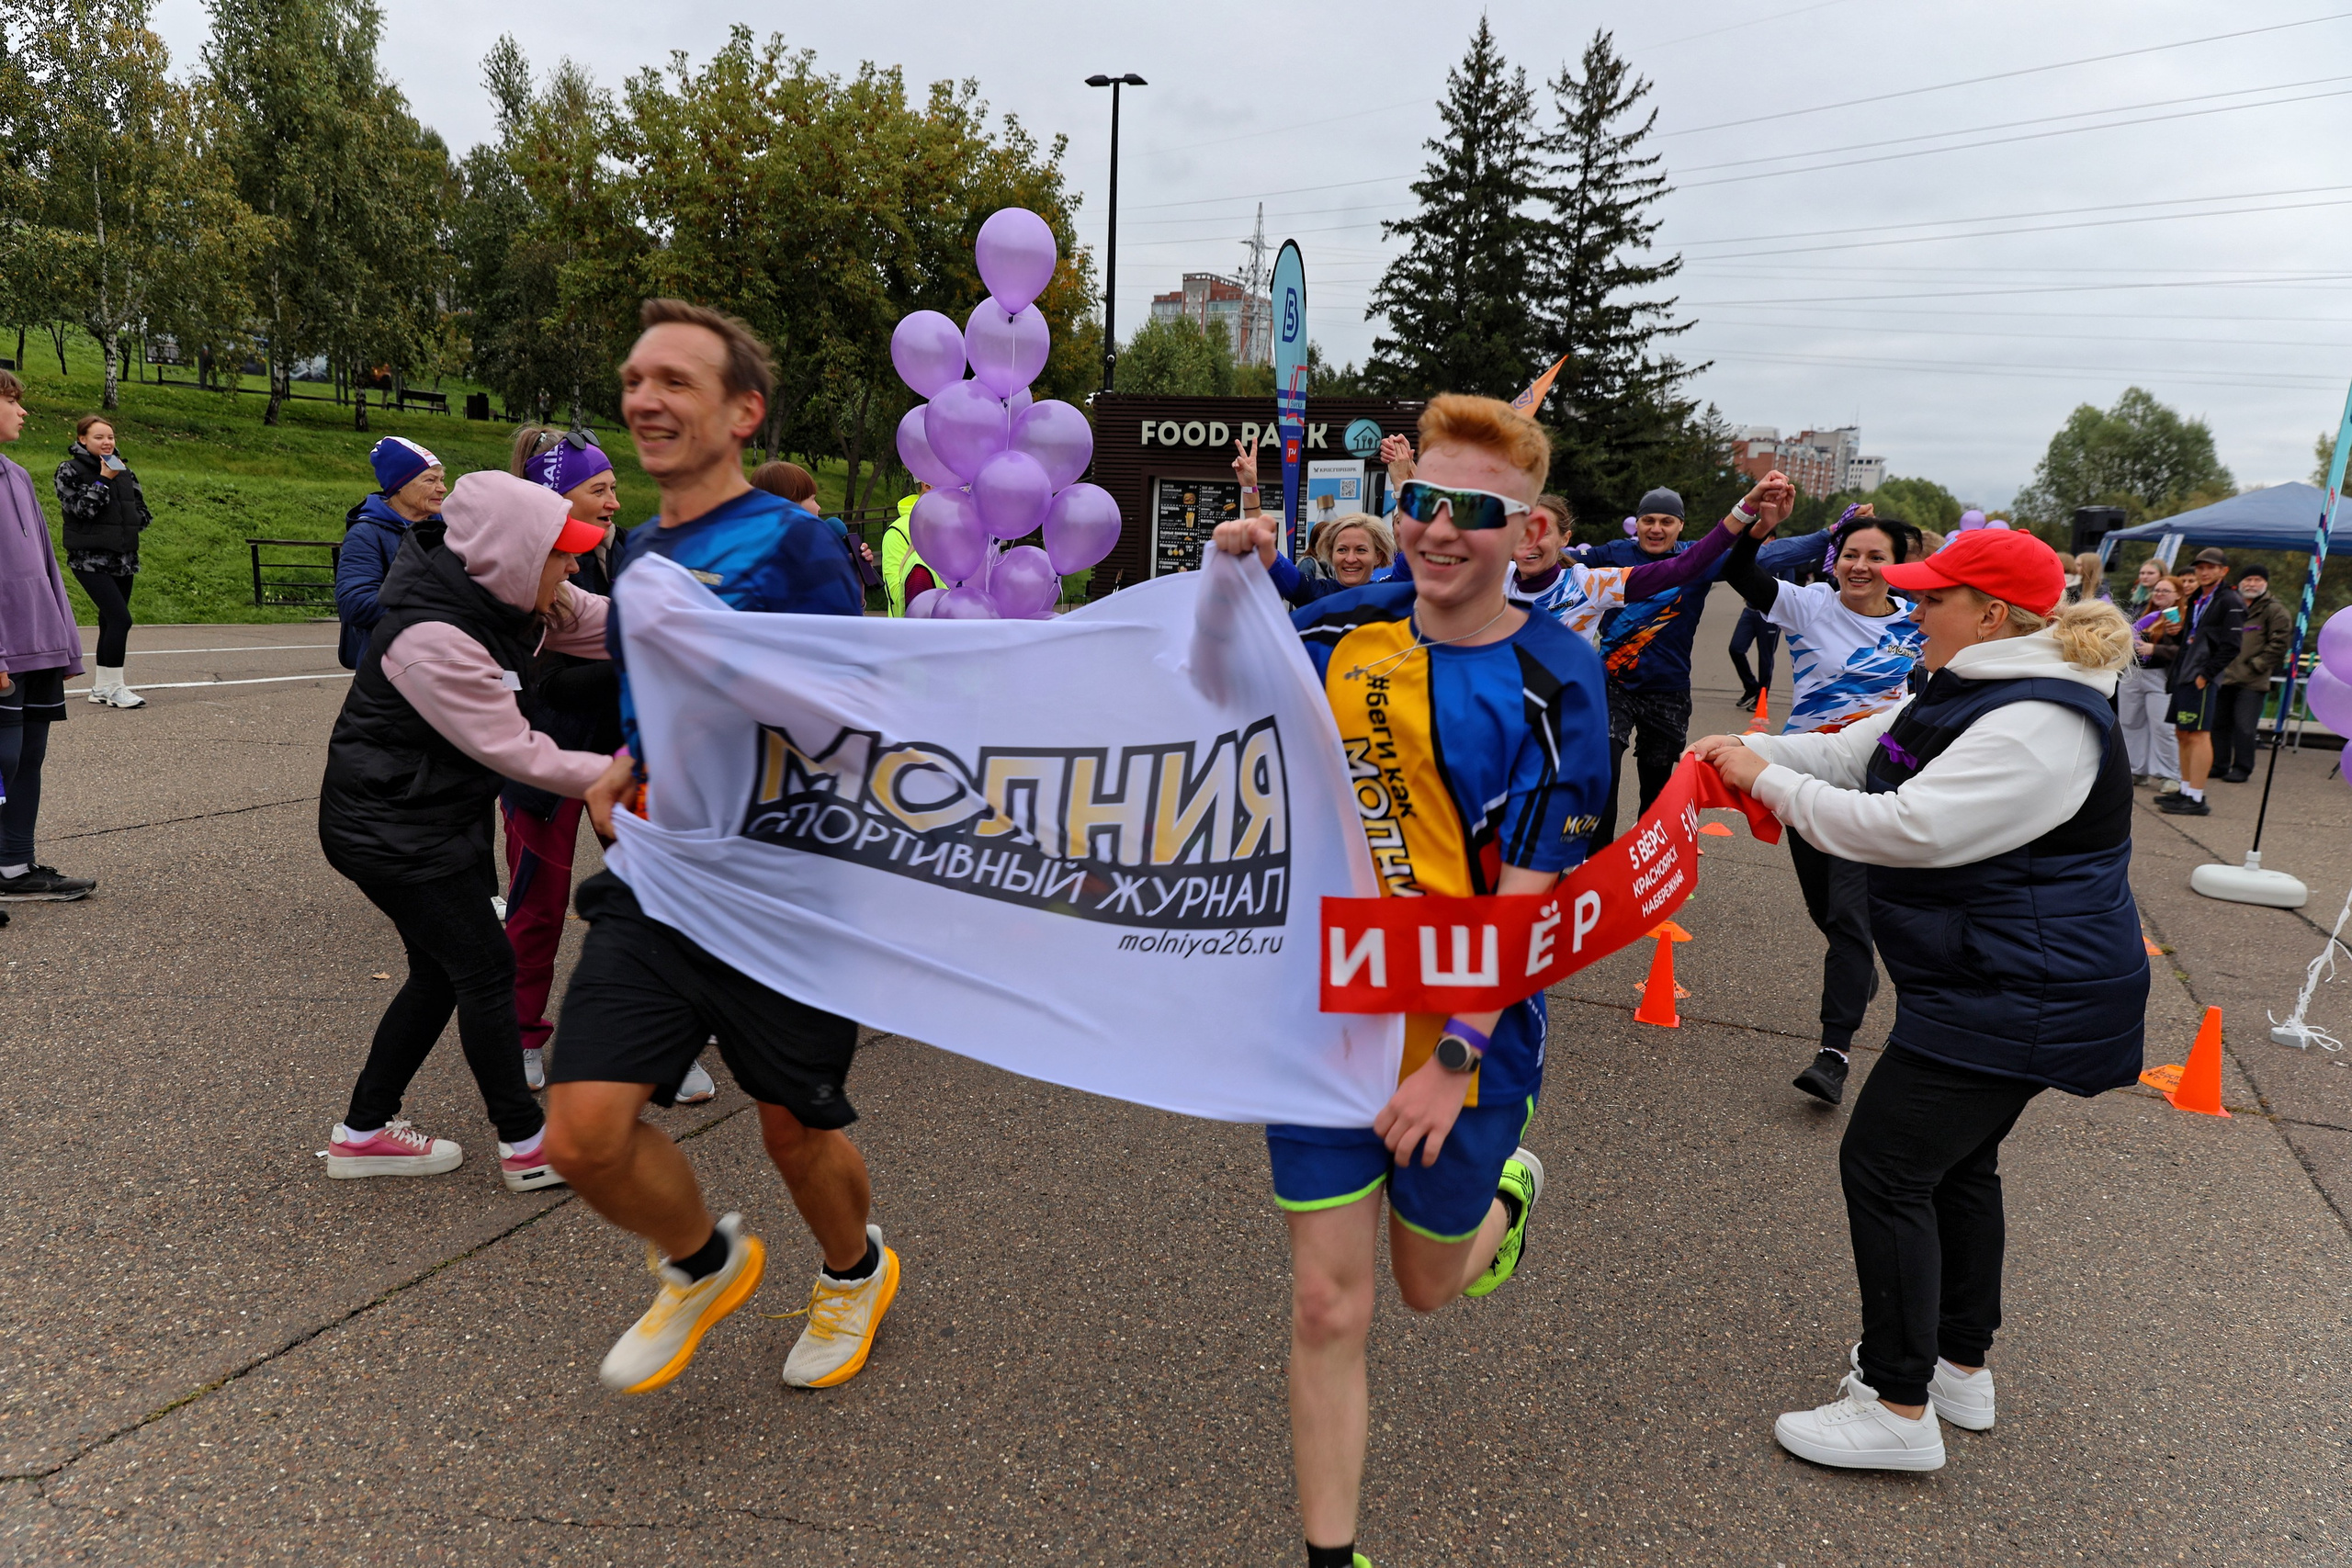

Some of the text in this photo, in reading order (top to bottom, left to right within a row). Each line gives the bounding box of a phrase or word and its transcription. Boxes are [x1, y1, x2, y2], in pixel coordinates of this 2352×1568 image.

[1141, 420, 1329, 448] FOOD PAK
[1366, 674, 1417, 818] #беги как
[755, 716, 1289, 866] МОЛНИЯ
[1628, 818, 1668, 870] 5 ВЁРСТ
[1680, 812, 1693, 843] 5
[747, 801, 1285, 919] СПОРТИВНЫЙ ЖУРНАЛ
[1633, 843, 1679, 898] КРАСНОЯРСК
[1641, 868, 1685, 919] НАБЕРЕЖНАЯ
[1117, 928, 1284, 960] molniya26.ru
